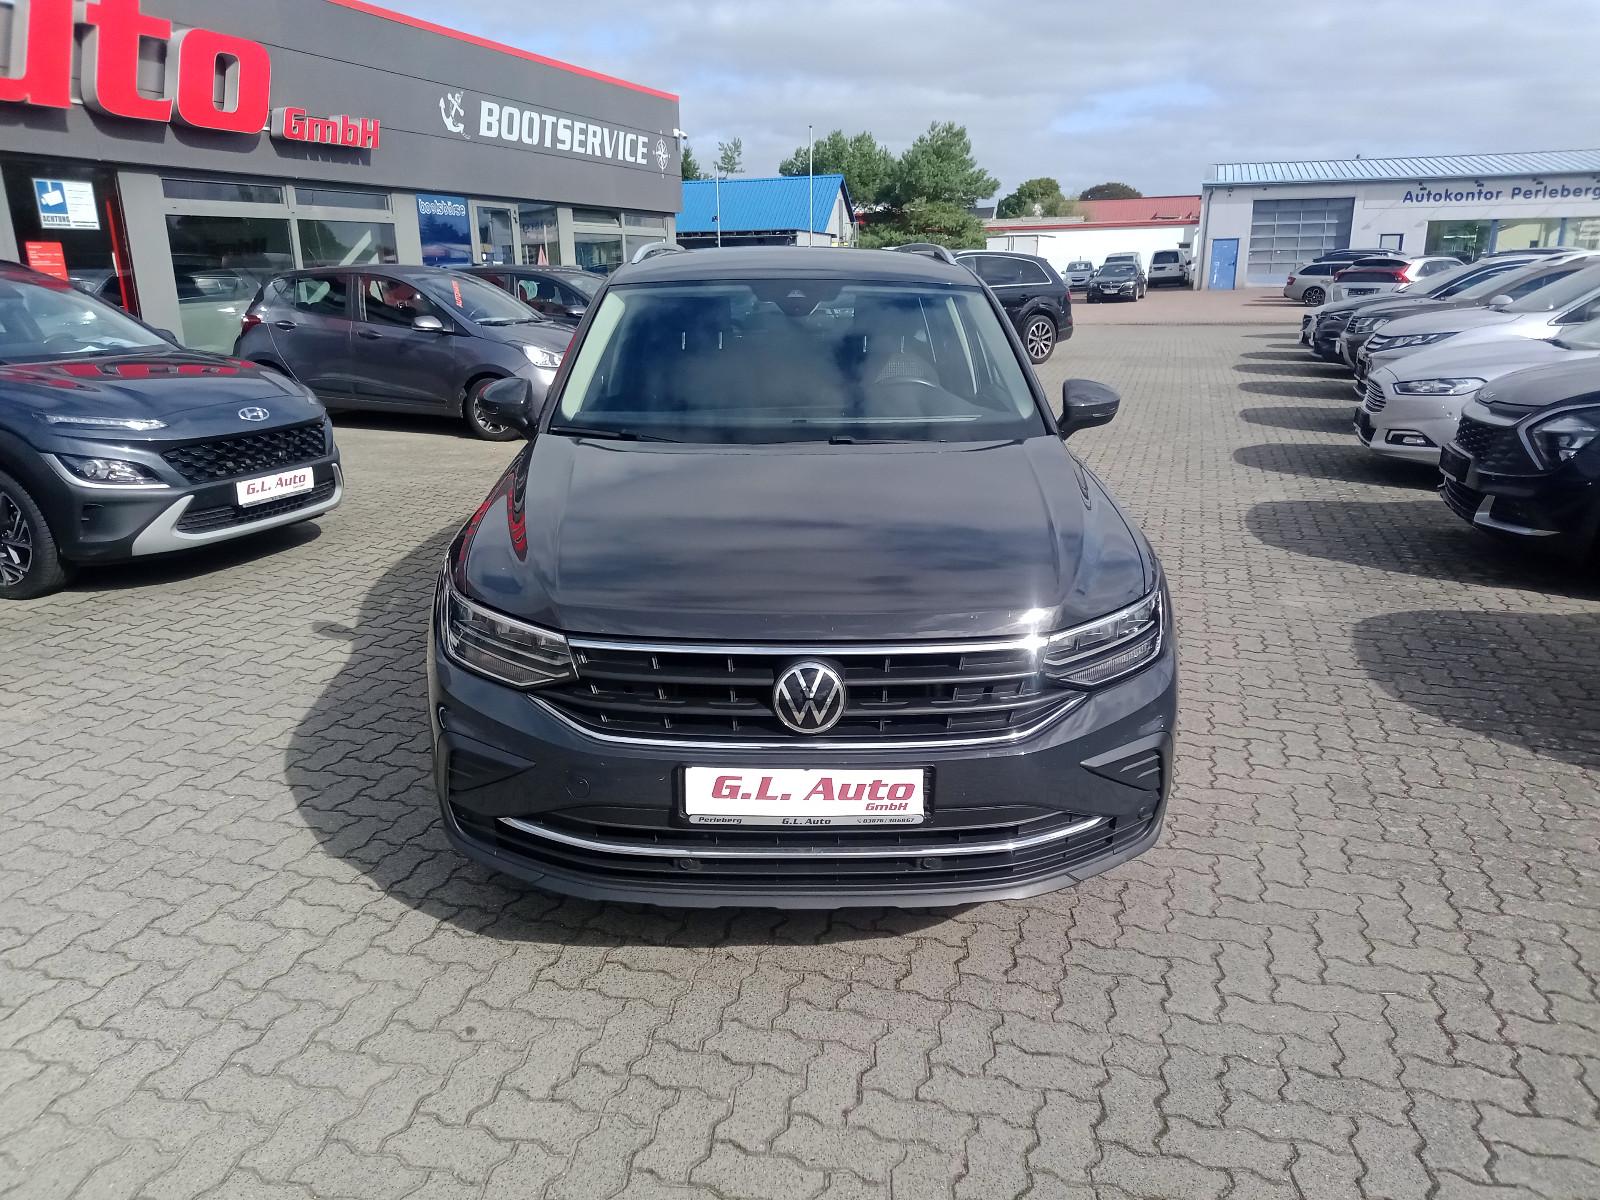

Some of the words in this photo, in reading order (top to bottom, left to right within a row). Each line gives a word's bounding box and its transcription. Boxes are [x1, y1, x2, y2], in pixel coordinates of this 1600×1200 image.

[283, 106, 381, 149] GmbH
[479, 100, 649, 165] BOOTSERVICE
[1402, 188, 1503, 204] Autokontor
[1511, 184, 1600, 200] Perleberg
[275, 474, 306, 489] Auto
[711, 775, 792, 801] G.L.
[803, 777, 916, 801] Auto
[865, 802, 909, 811] GmbH
[698, 816, 742, 825] Perleberg
